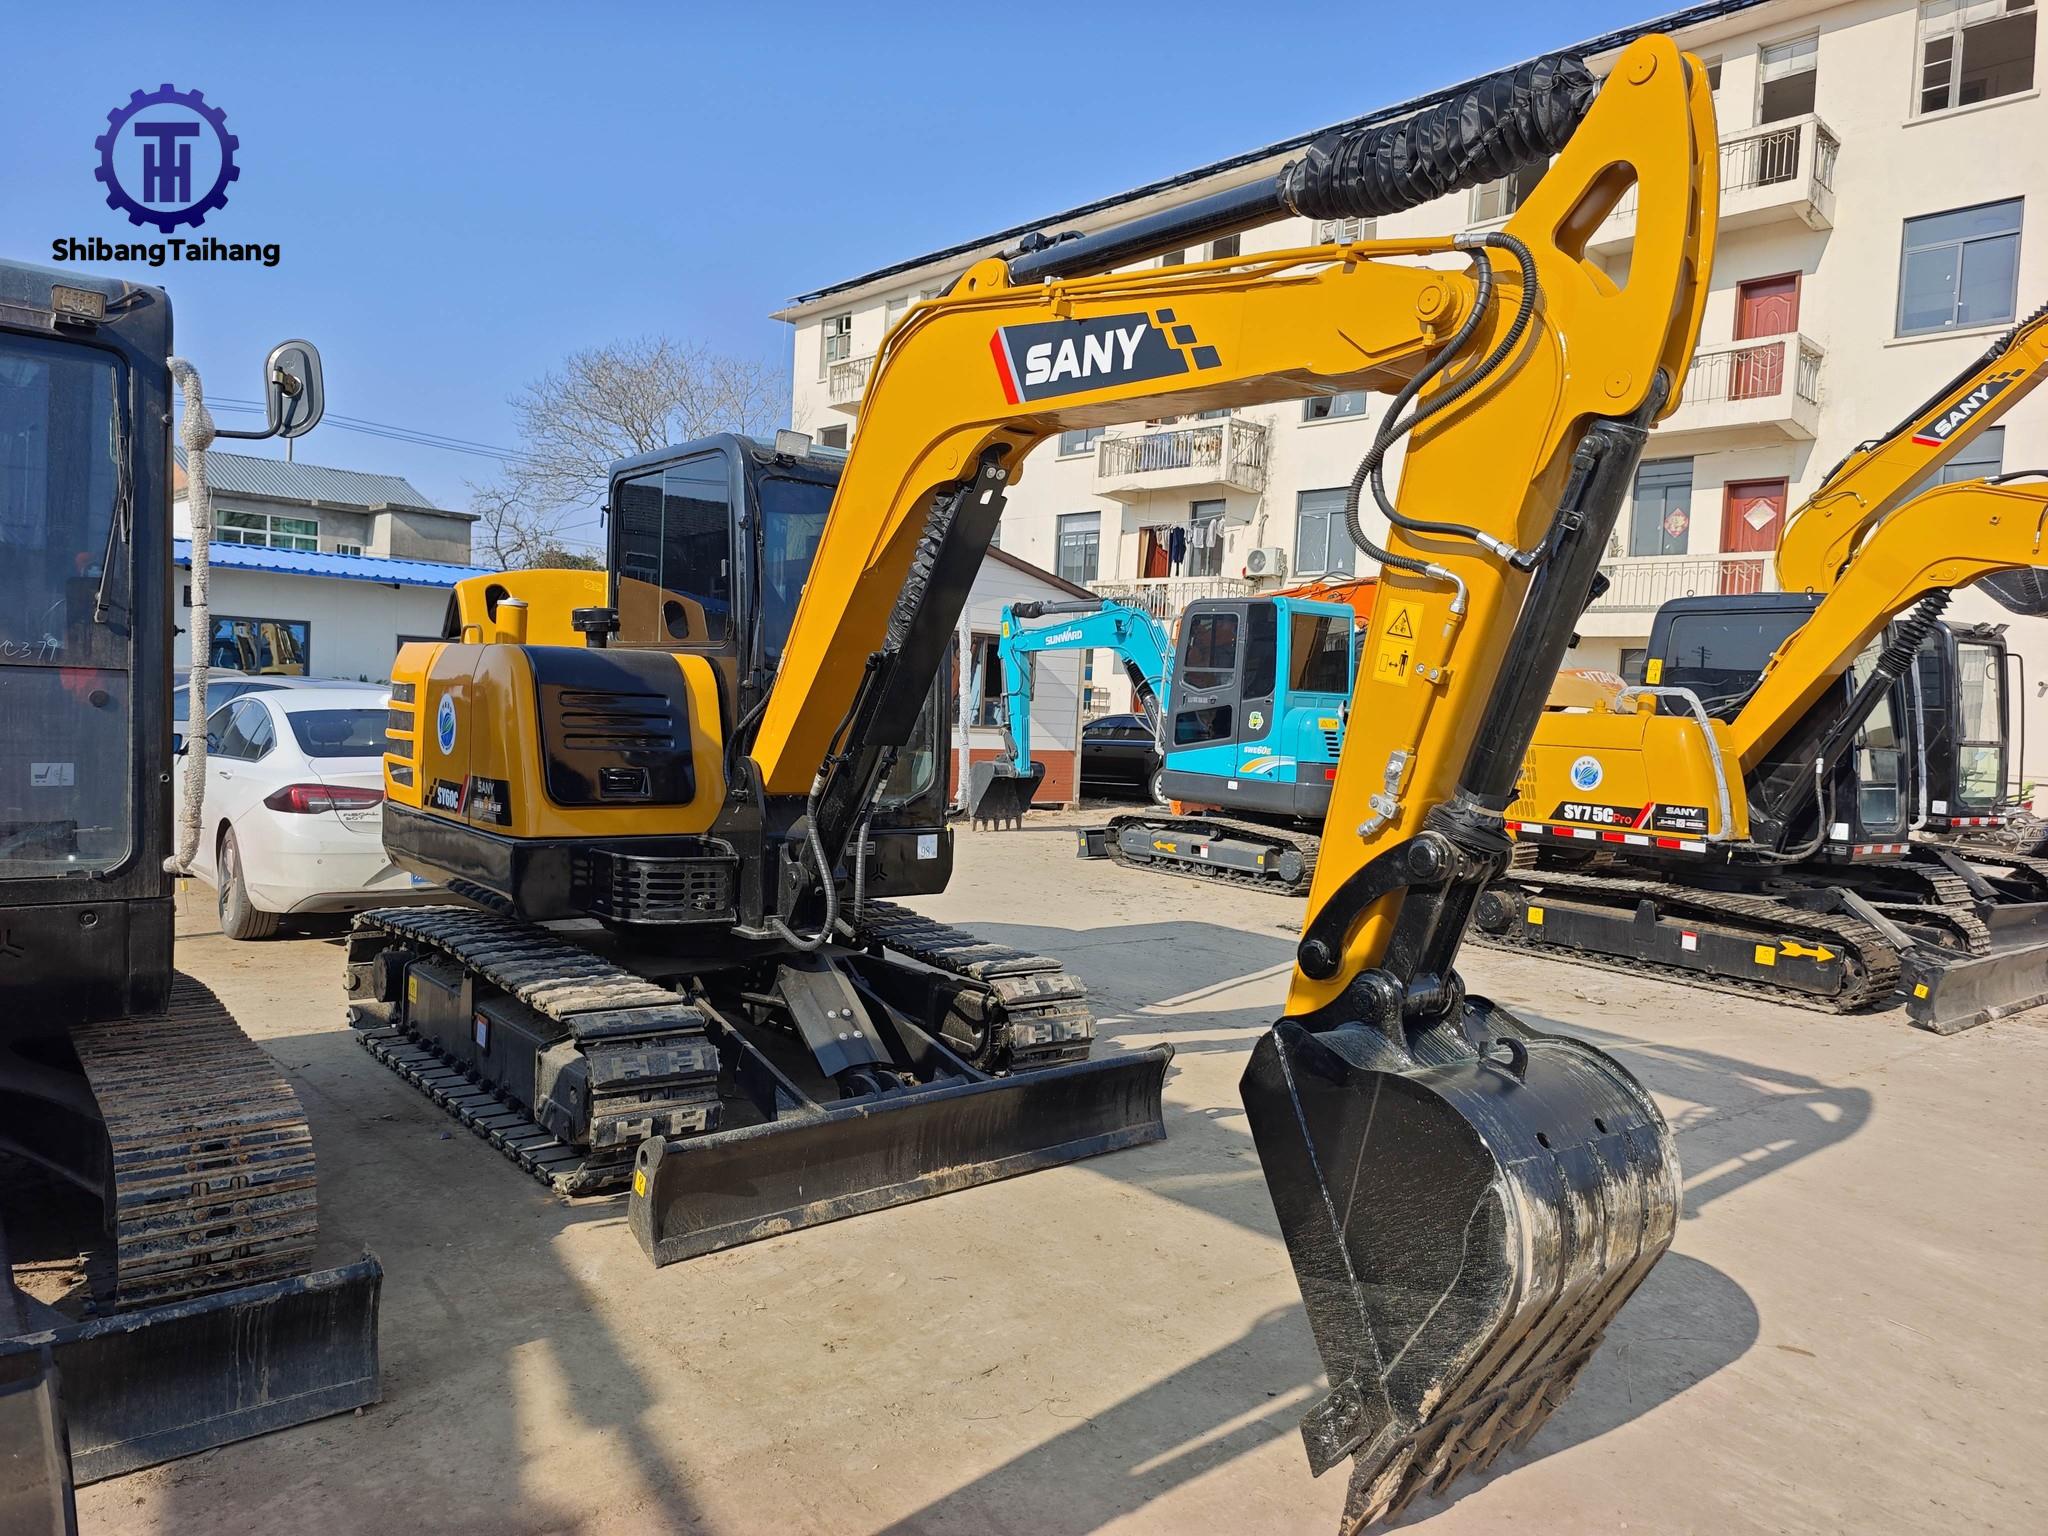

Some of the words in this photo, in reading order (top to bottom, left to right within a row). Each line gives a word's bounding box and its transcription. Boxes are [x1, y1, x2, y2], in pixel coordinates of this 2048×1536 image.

[1025, 323, 1148, 386] SANY
[1934, 384, 1990, 437] SANY
[1045, 626, 1083, 646] SUNWARD
[477, 779, 496, 795] SANY
[1665, 806, 1699, 817] SANY
